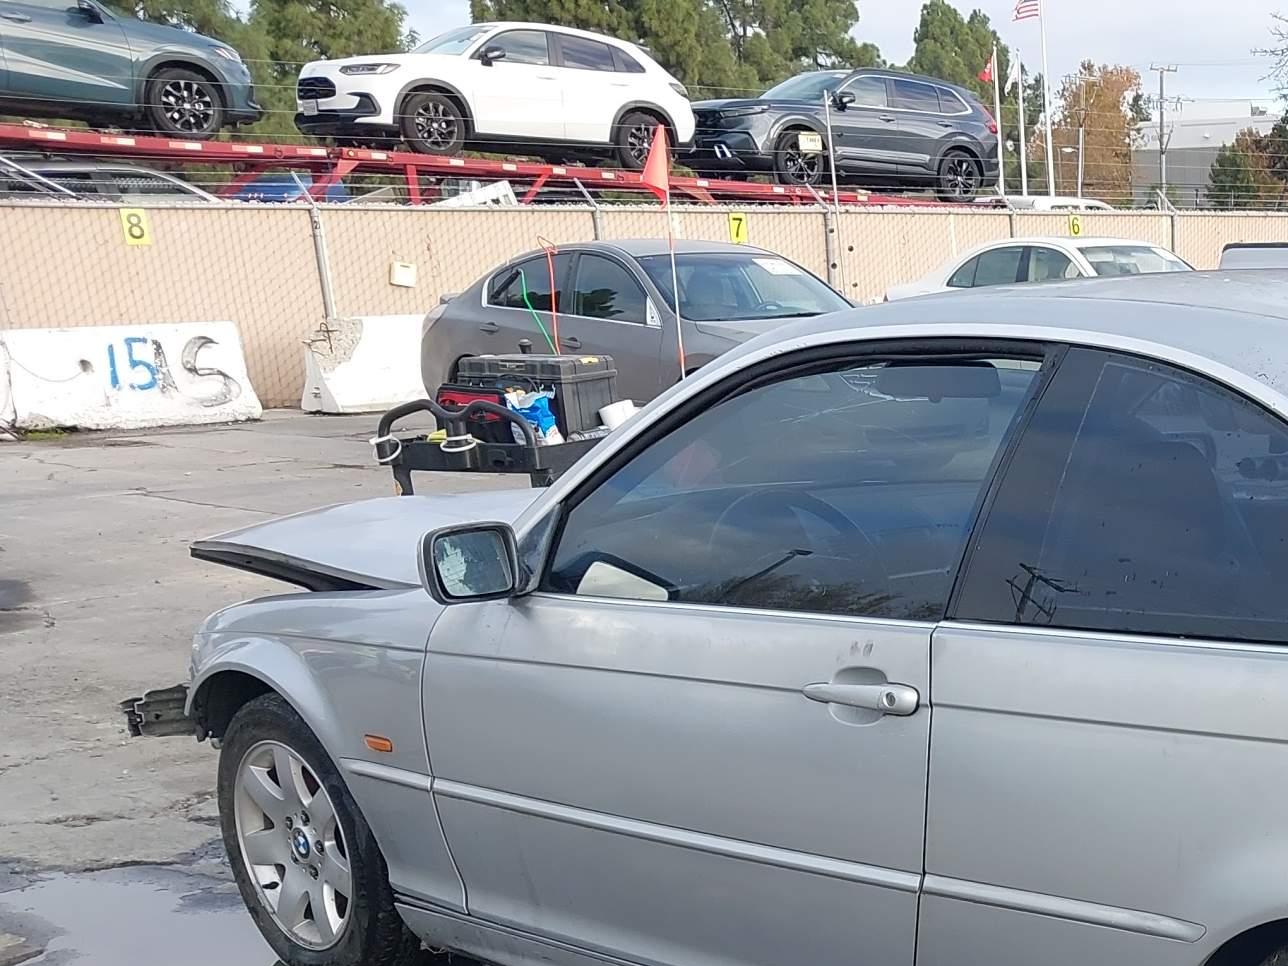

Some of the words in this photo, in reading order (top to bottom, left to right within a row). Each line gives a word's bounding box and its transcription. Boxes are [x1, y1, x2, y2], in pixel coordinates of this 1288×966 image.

[126, 213, 145, 239] 8
[732, 217, 743, 238] 7
[1071, 216, 1080, 235] 6
